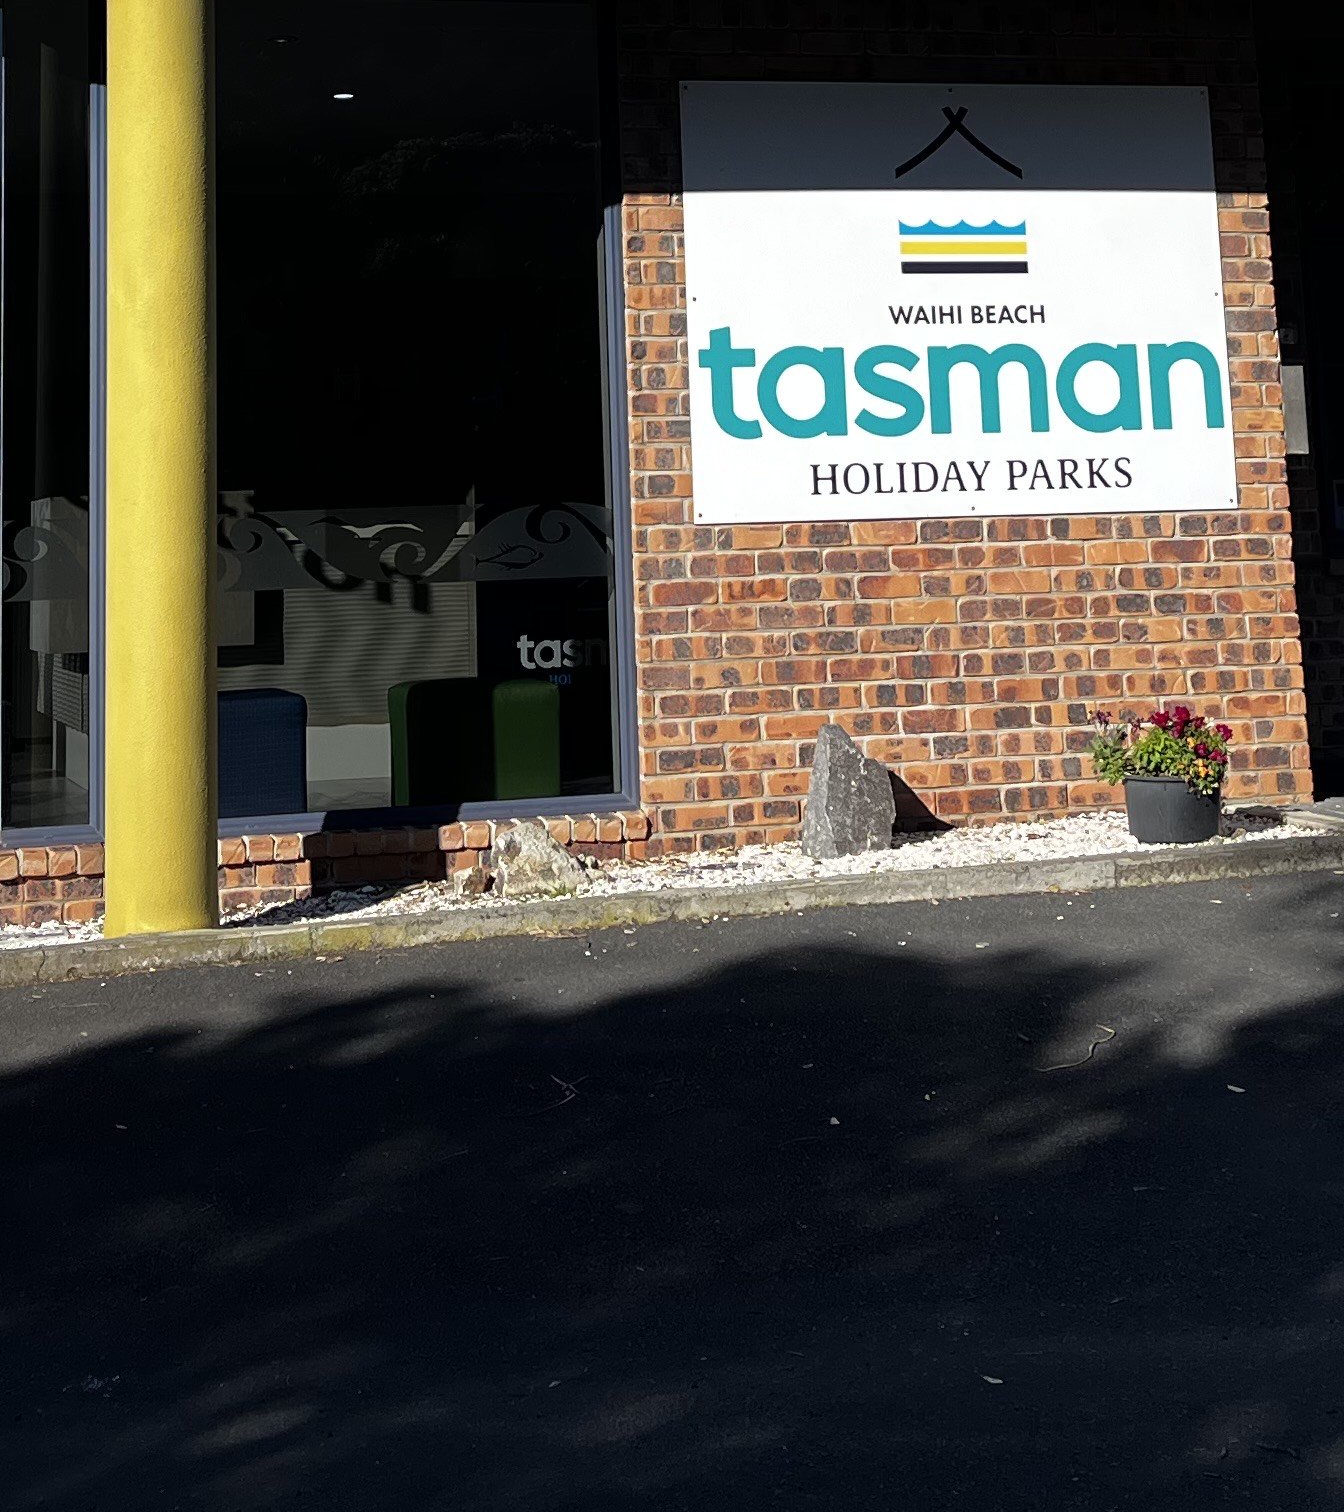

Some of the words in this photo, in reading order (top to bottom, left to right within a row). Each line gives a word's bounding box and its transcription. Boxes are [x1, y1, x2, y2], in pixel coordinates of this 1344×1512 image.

[888, 305, 963, 325] WAIHI
[970, 304, 1046, 324] BEACH
[698, 326, 1225, 440] tasman
[810, 460, 991, 496] HOLIDAY
[1006, 456, 1133, 491] PARKS
